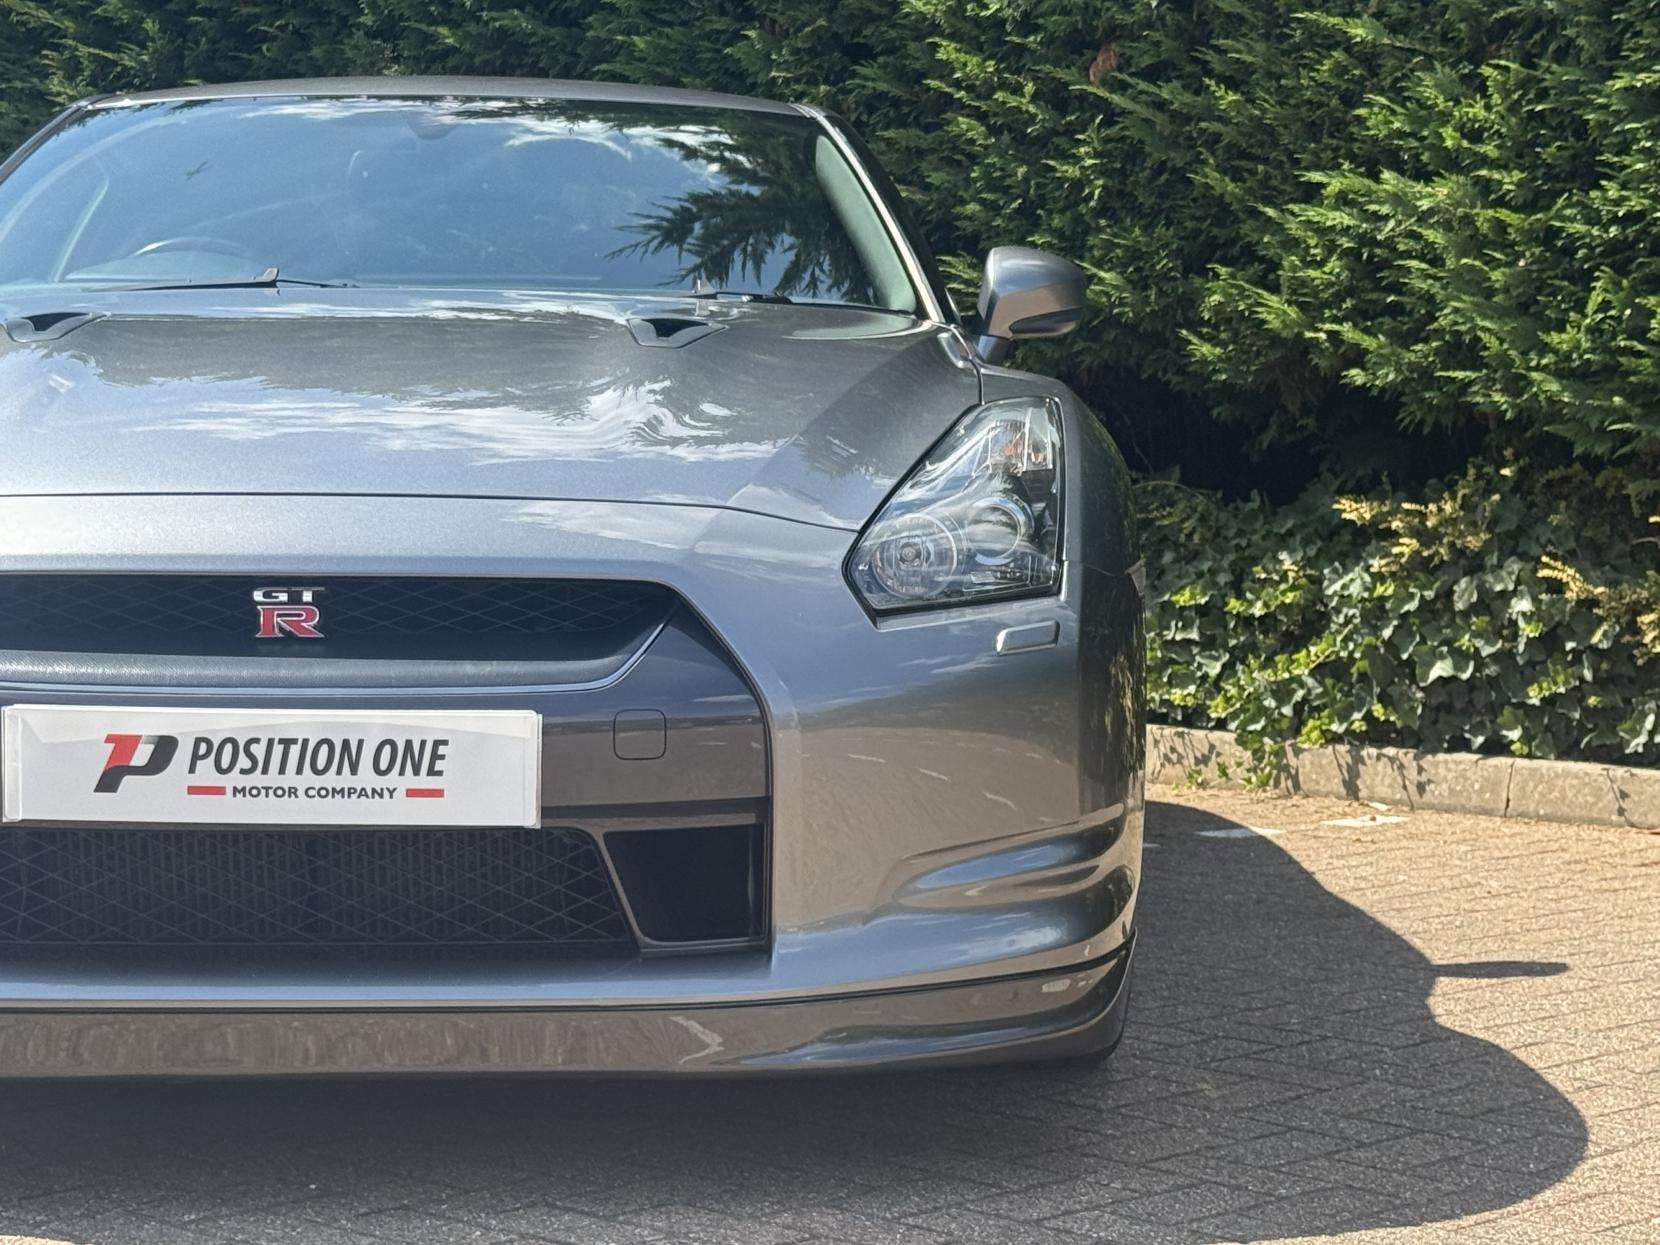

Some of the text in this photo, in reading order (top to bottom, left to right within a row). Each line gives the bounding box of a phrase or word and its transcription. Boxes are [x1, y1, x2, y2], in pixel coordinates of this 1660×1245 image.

[252, 586, 325, 603] GT
[254, 605, 325, 638] R
[187, 736, 449, 777] POSITION ONE
[232, 785, 398, 800] MOTOR COMPANY
